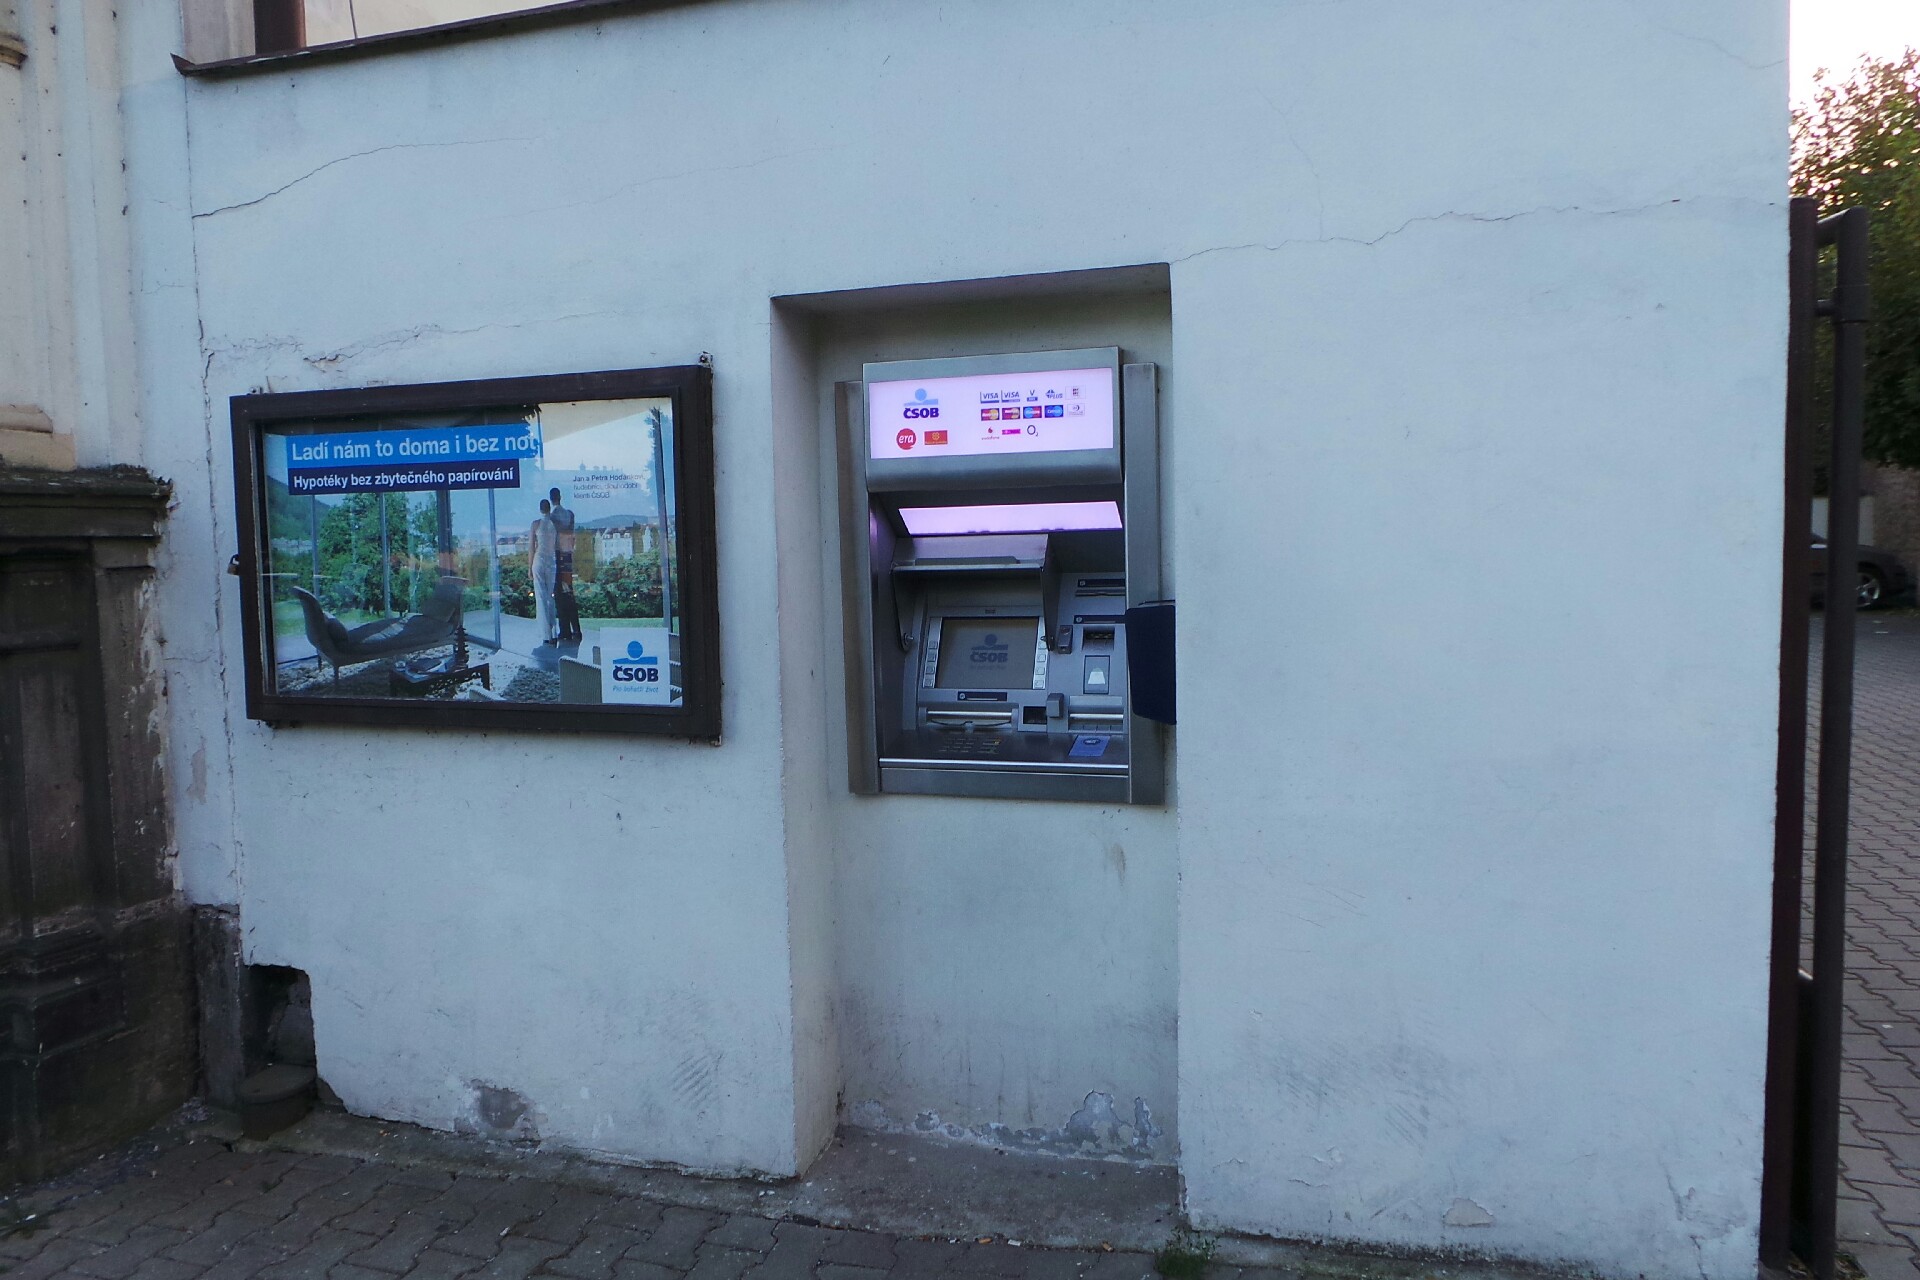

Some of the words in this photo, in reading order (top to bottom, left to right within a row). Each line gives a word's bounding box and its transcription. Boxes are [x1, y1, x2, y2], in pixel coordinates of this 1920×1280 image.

[1004, 391, 1020, 399] VISA
[903, 407, 939, 419] ČSOB
[898, 434, 914, 444] era
[292, 441, 329, 460] Ladí
[333, 440, 370, 459] nám
[375, 440, 394, 457] to
[399, 437, 450, 456] doma
[455, 435, 461, 454] i
[465, 434, 500, 453] bez
[293, 474, 348, 490] Hypotéky
[351, 473, 372, 485] bez
[374, 470, 445, 487] zbytečného
[448, 467, 514, 485] papírování
[591, 490, 610, 498] ČSOB
[970, 651, 1008, 663] ČSOB
[612, 665, 659, 682] ČSOB
